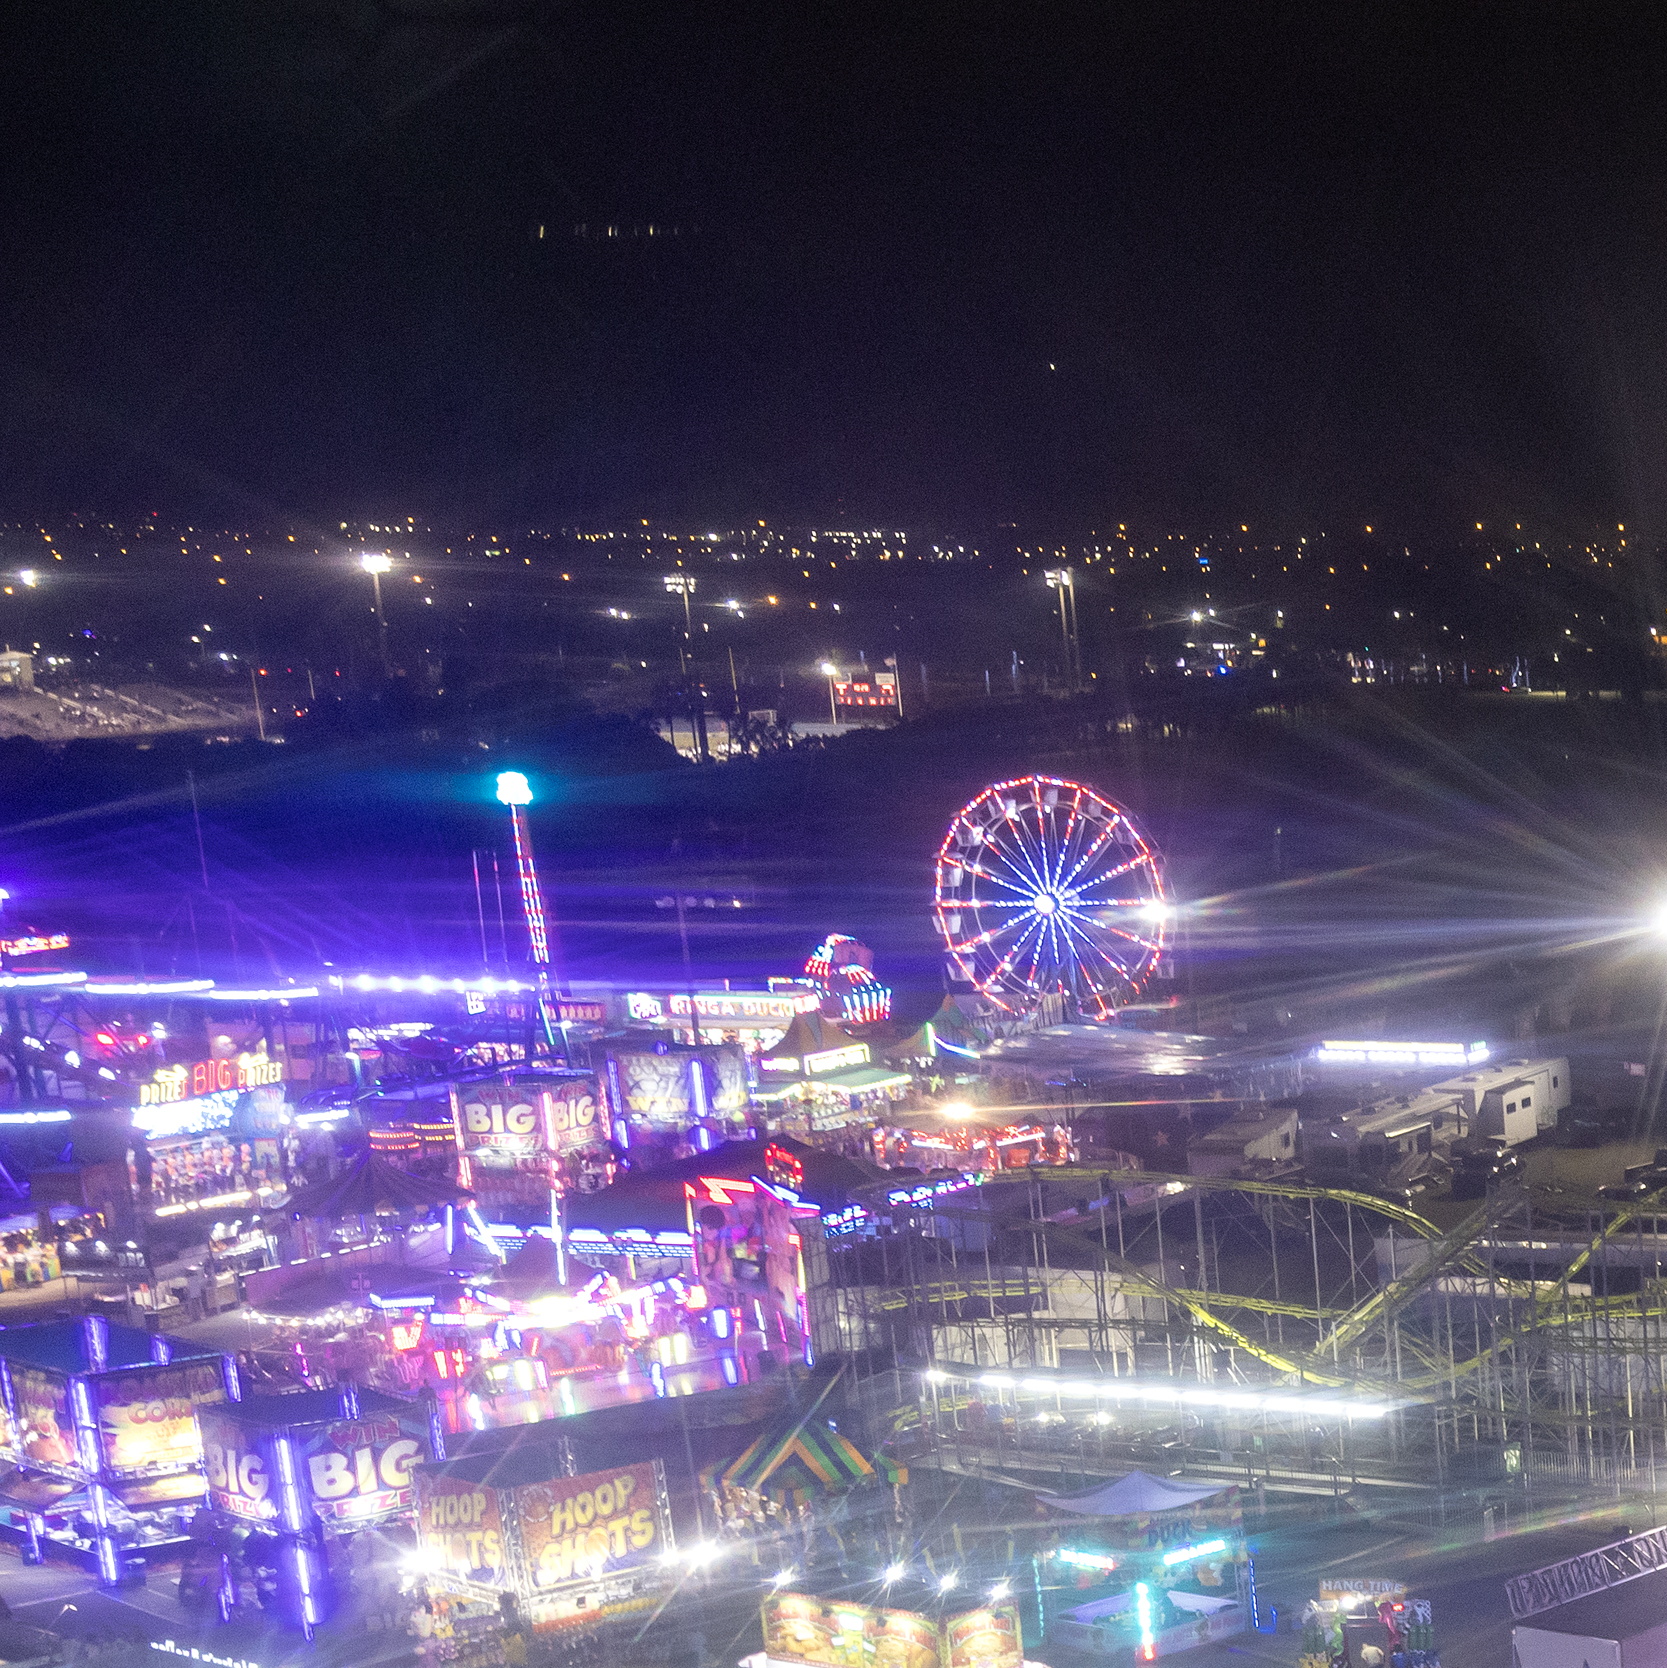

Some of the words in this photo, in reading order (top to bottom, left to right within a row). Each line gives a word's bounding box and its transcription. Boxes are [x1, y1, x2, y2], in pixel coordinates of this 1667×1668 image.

[194, 1059, 231, 1090] BIG
[465, 1104, 536, 1135] BIG
[554, 1096, 595, 1130] BIG
[330, 1419, 401, 1449] WIN
[208, 1444, 269, 1501] BIG
[309, 1439, 424, 1499] BIG
[431, 1492, 486, 1526] HOOP
[552, 1475, 637, 1539] HOOP
[428, 1529, 501, 1571] SHOTS
[537, 1509, 654, 1587] SHOTS
[1322, 1580, 1363, 1591] HANG
[1369, 1580, 1402, 1593] TIME
